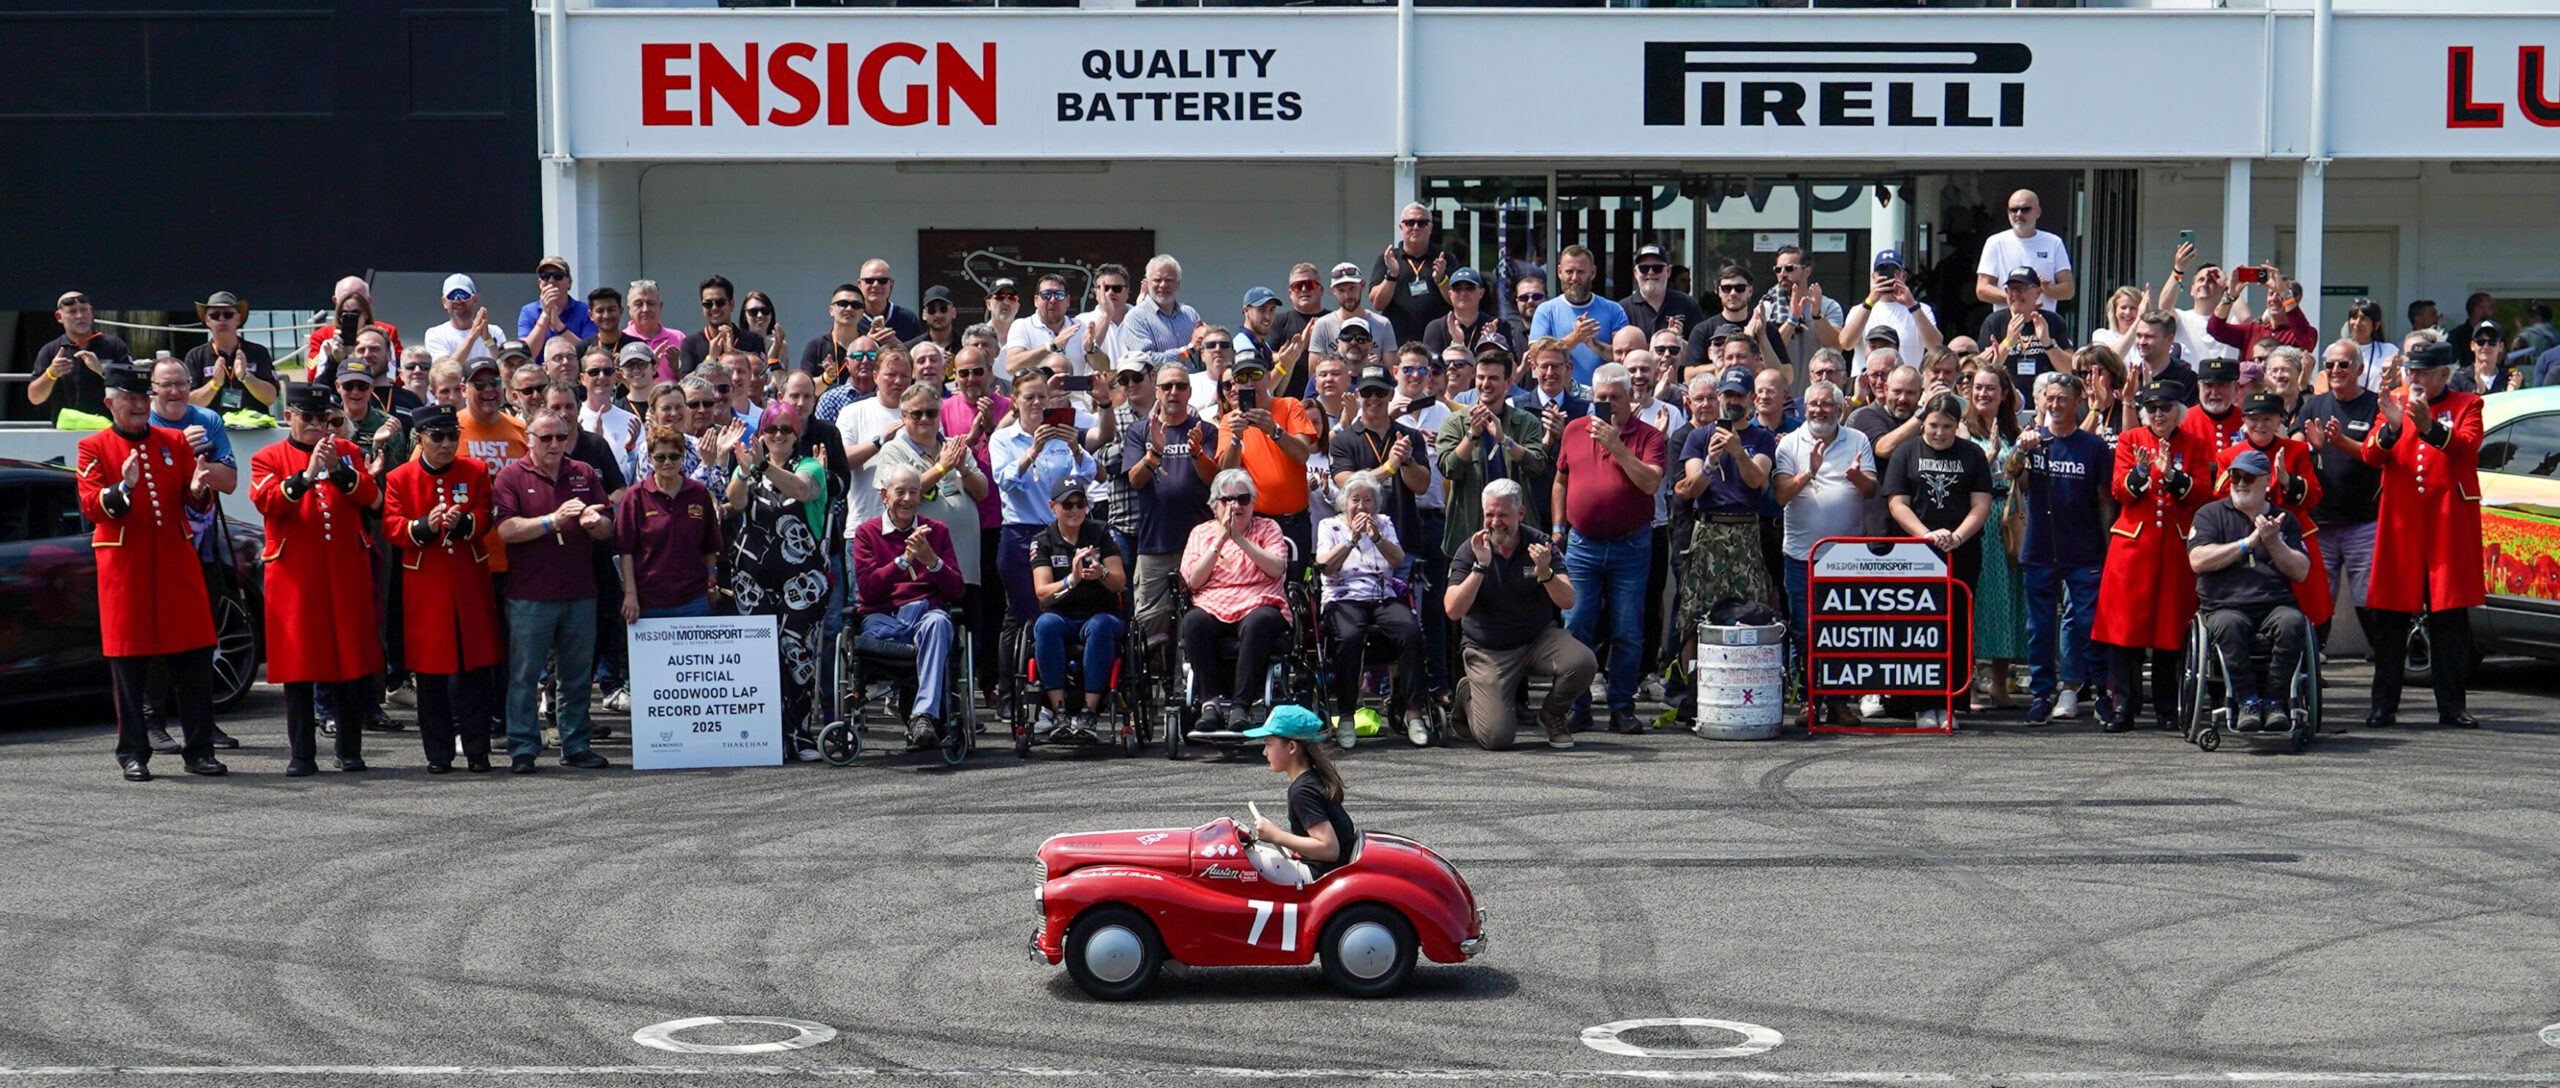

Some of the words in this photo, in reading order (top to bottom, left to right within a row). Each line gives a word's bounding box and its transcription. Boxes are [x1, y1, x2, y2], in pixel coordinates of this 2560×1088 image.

[1081, 48, 1277, 81] QUALITY
[641, 41, 996, 127] ENSIGN
[1643, 41, 2033, 127] PIRELLI
[1056, 91, 1303, 123] BATTERIES
[468, 440, 508, 457] JUST
[1918, 458, 1965, 472] NIRVANA
[1827, 562, 1858, 571] MISSION
[1859, 562, 1913, 571] MOTORSPORT
[1822, 588, 1936, 611] ALYSSA
[635, 630, 675, 641] MISSION
[677, 629, 743, 640] MOTORSPORT
[1817, 627, 1894, 648] AUSTIN
[1901, 627, 1939, 648] J40
[667, 655, 714, 666] AUSTIN
[718, 653, 741, 665] J40
[676, 671, 734, 683] OFFICIAL
[1822, 664, 1873, 685] LAP
[1880, 664, 1941, 685] TIME
[653, 688, 728, 701] GOODWOOD
[732, 686, 758, 698] LAP
[648, 705, 700, 717] RECORD
[705, 703, 765, 716] ATTEMPT
[692, 721, 722, 733] 2025
[722, 741, 768, 749] THAKEHAM
[1247, 899, 1298, 952] 71
